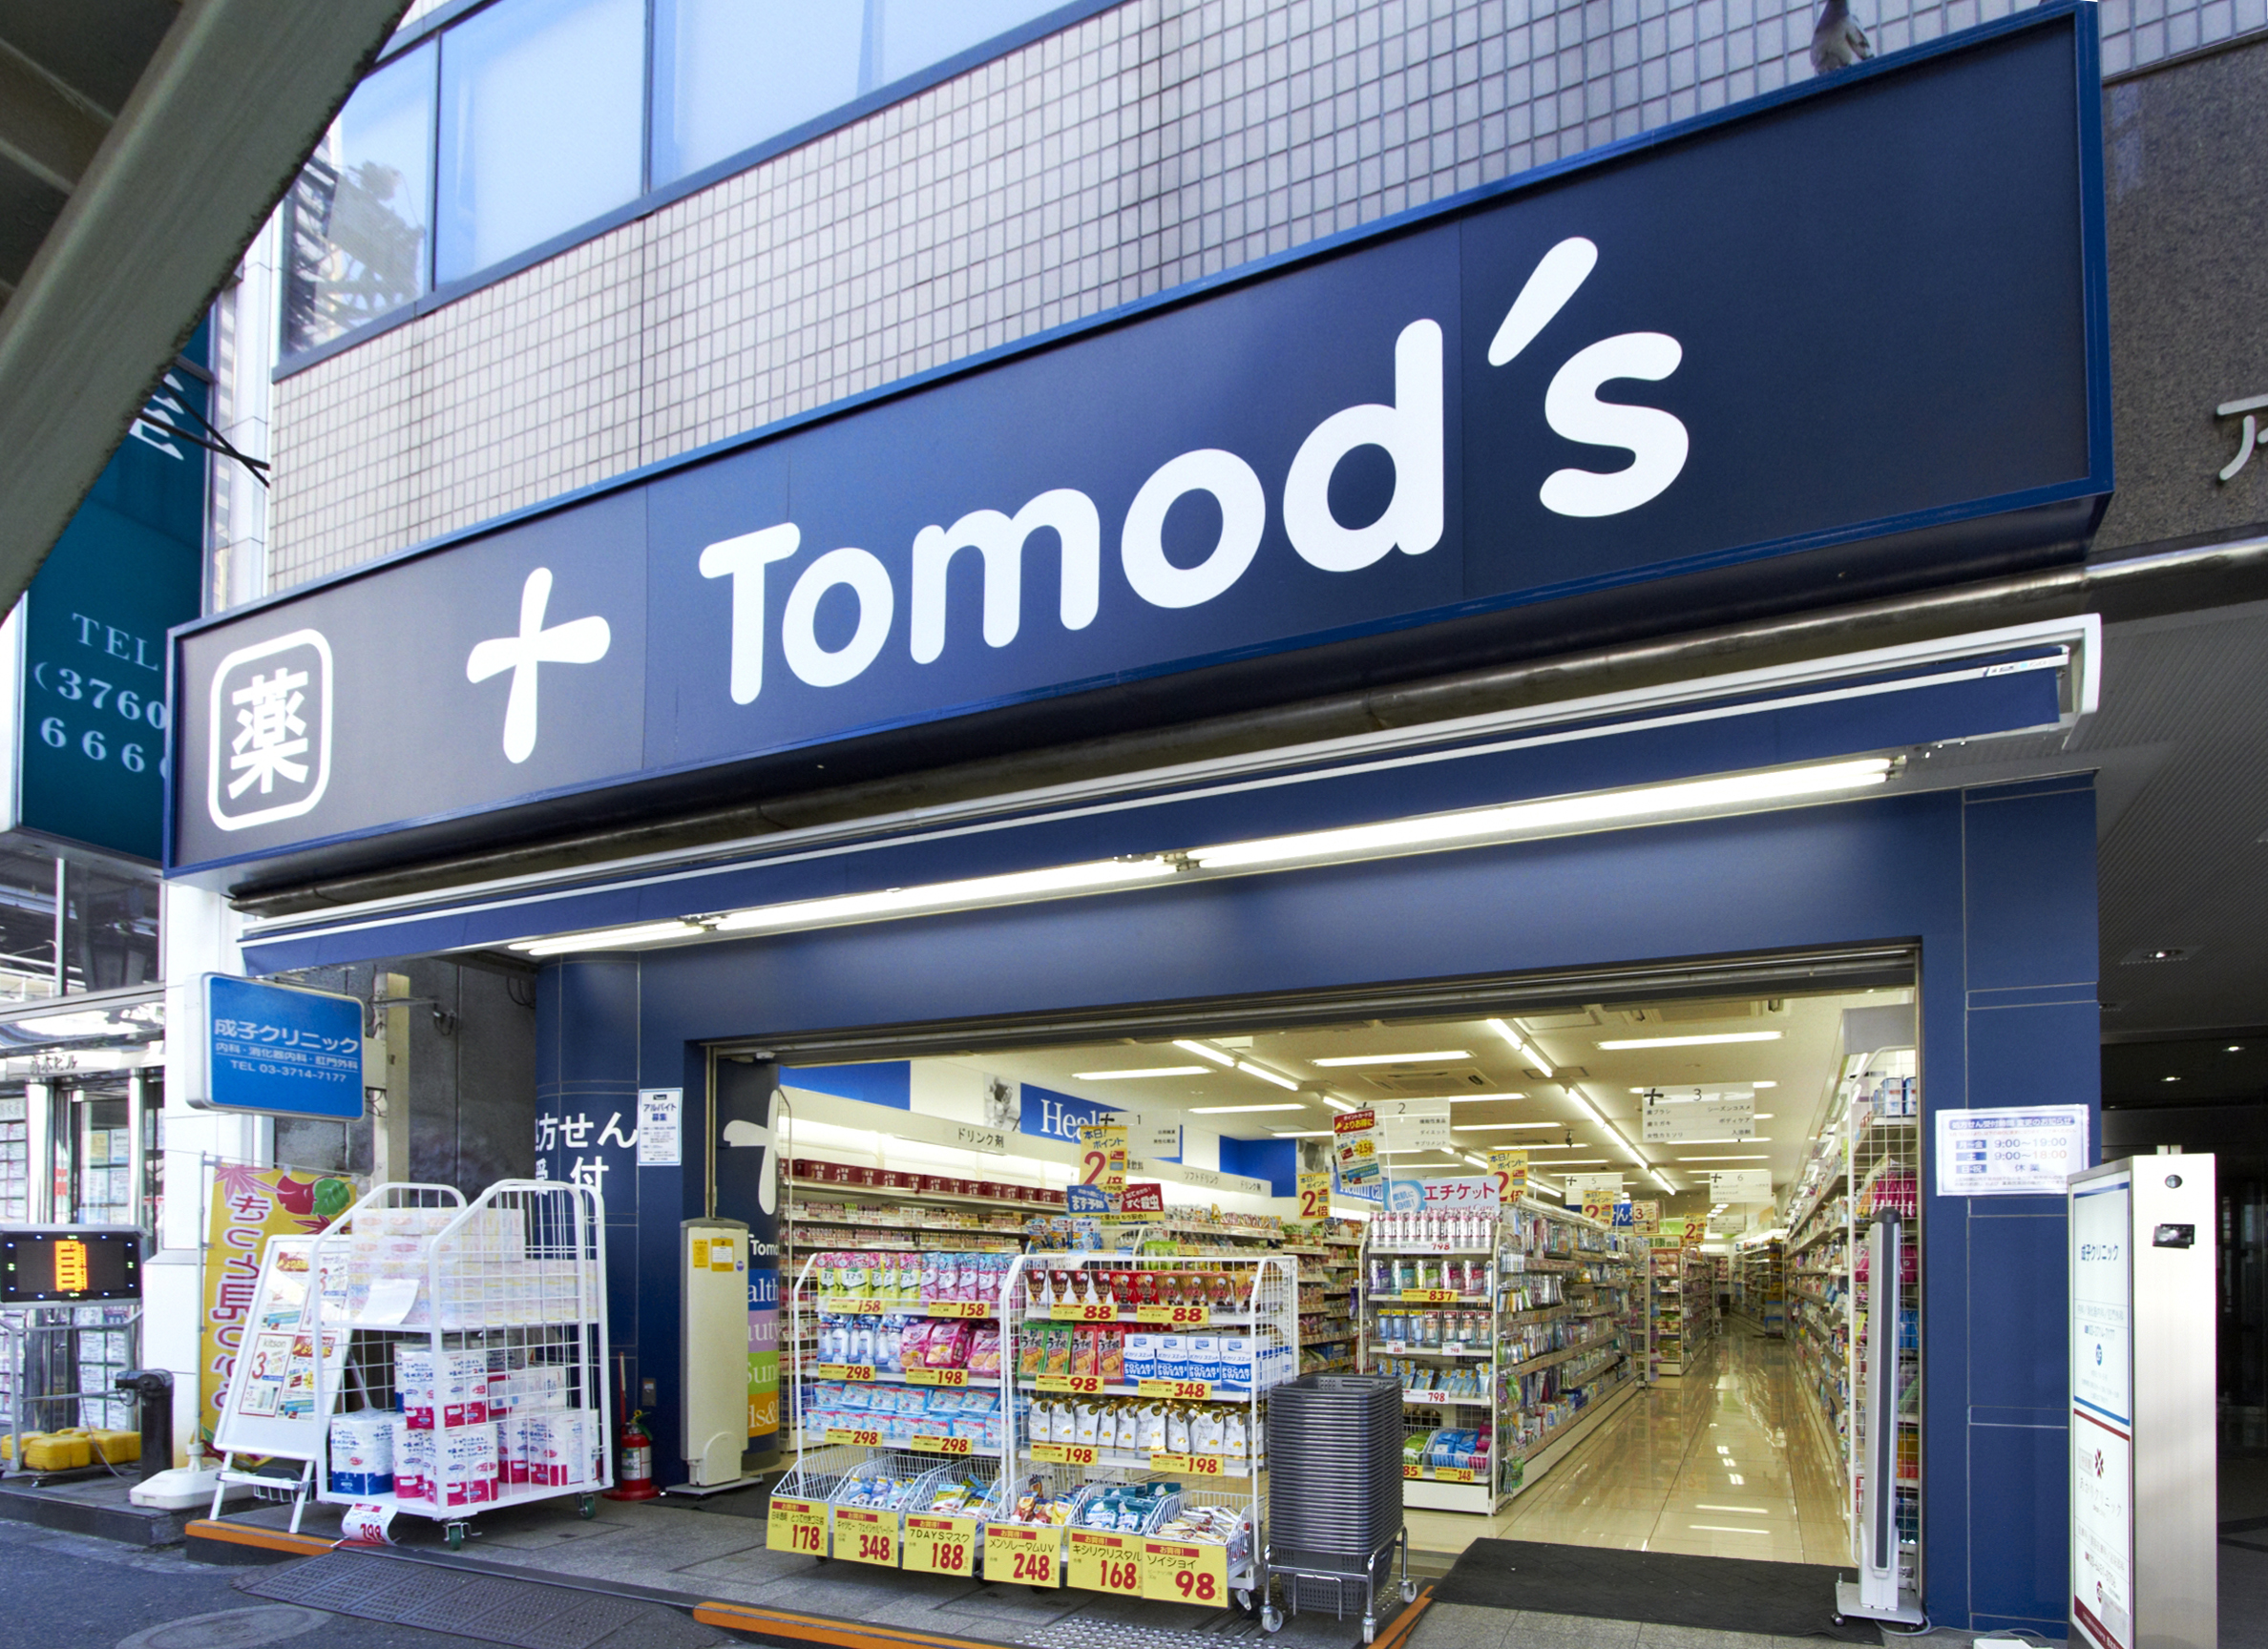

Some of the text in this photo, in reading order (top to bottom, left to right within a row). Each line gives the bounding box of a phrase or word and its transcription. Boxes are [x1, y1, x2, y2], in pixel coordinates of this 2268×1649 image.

[699, 236, 1690, 705] Tomod's
[72, 612, 159, 671] TEL
[227, 666, 310, 800] 薬
[40, 717, 168, 780] 666
[214, 1018, 359, 1054] 成子クリニック
[230, 1059, 346, 1082] TEL 03-3714-7177
[1692, 1088, 1702, 1101] 3
[643, 1103, 677, 1112] アルバイト
[1397, 1102, 1406, 1115] 2
[1707, 1104, 1751, 1113] シーズンコスメ
[1137, 1114, 1142, 1125] 1
[536, 1111, 639, 1152] 方せん
[957, 1127, 1005, 1148] ドリンク剤
[1093, 1138, 1124, 1149] ポイント
[1497, 1159, 1524, 1170] ポイント
[1184, 1171, 1219, 1185] ソフトドリンク
[1737, 1173, 1744, 1181] 6
[1307, 1180, 1327, 1189] ポイント
[1423, 1181, 1496, 1201] エチケット
[1301, 1190, 1329, 1217] 2 倍
[1635, 1208, 1644, 1220] 3
[1685, 1223, 1696, 1240] 2
[1431, 1242, 1451, 1251] 798
[747, 1277, 780, 1303] alth
[1428, 1290, 1454, 1301] 837
[857, 1300, 881, 1313] 158
[960, 1303, 985, 1316] 158
[1083, 1305, 1112, 1320] 88
[1171, 1307, 1203, 1323] 88
[262, 1338, 287, 1348] kitson
[252, 1351, 267, 1380] 3
[1124, 1362, 1155, 1370] POCARI
[1157, 1364, 1186, 1372] POCARI
[1188, 1365, 1219, 1373] POCARI
[1221, 1367, 1250, 1375] POCAR
[846, 1366, 871, 1380] 298
[937, 1370, 963, 1385] 198
[1158, 1369, 1185, 1378] SWEAT
[1223, 1372, 1250, 1381] SWEAT
[1069, 1377, 1099, 1391] 98
[1174, 1383, 1206, 1398] 348
[1428, 1392, 1445, 1402] 798
[852, 1430, 878, 1445] 298
[941, 1438, 968, 1452] 298
[1065, 1448, 1093, 1464] 198
[1187, 1457, 1218, 1473] 198
[1458, 1470, 1472, 1481] 348
[792, 1524, 820, 1551] 178
[910, 1528, 971, 1542] 7DAYSマスク
[859, 1534, 891, 1561] 348
[988, 1538, 1055, 1554] メンソレータムUV
[1072, 1543, 1143, 1561] キシリクリスタル
[932, 1542, 964, 1570] 188
[1146, 1555, 1197, 1569] ソイジョイ
[1013, 1552, 1050, 1581] 248
[1101, 1559, 1137, 1590] 168
[1175, 1570, 1216, 1600] 98
